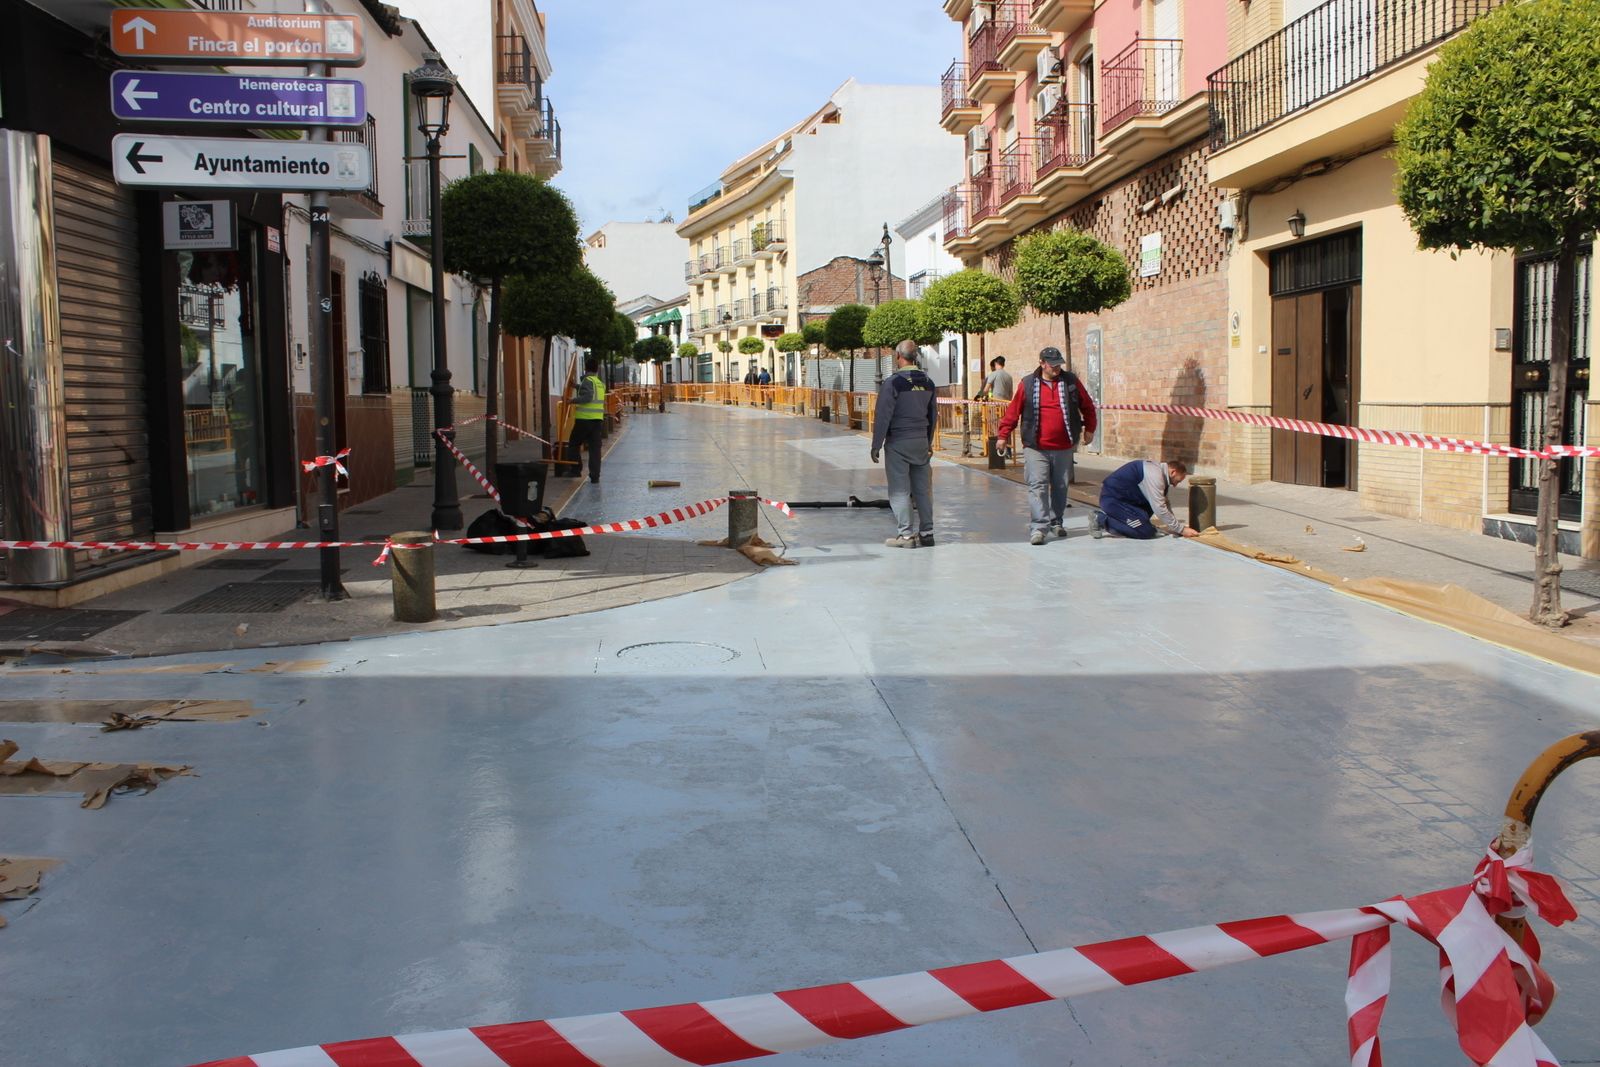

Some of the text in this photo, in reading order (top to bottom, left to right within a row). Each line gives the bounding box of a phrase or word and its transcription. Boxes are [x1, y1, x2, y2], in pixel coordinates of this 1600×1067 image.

[247, 16, 321, 29] Auditorium
[188, 36, 322, 56] Finca el portón
[239, 78, 323, 92] Hemeroteca
[189, 98, 324, 117] Centro cultural
[194, 152, 330, 176] Ayuntamiento
